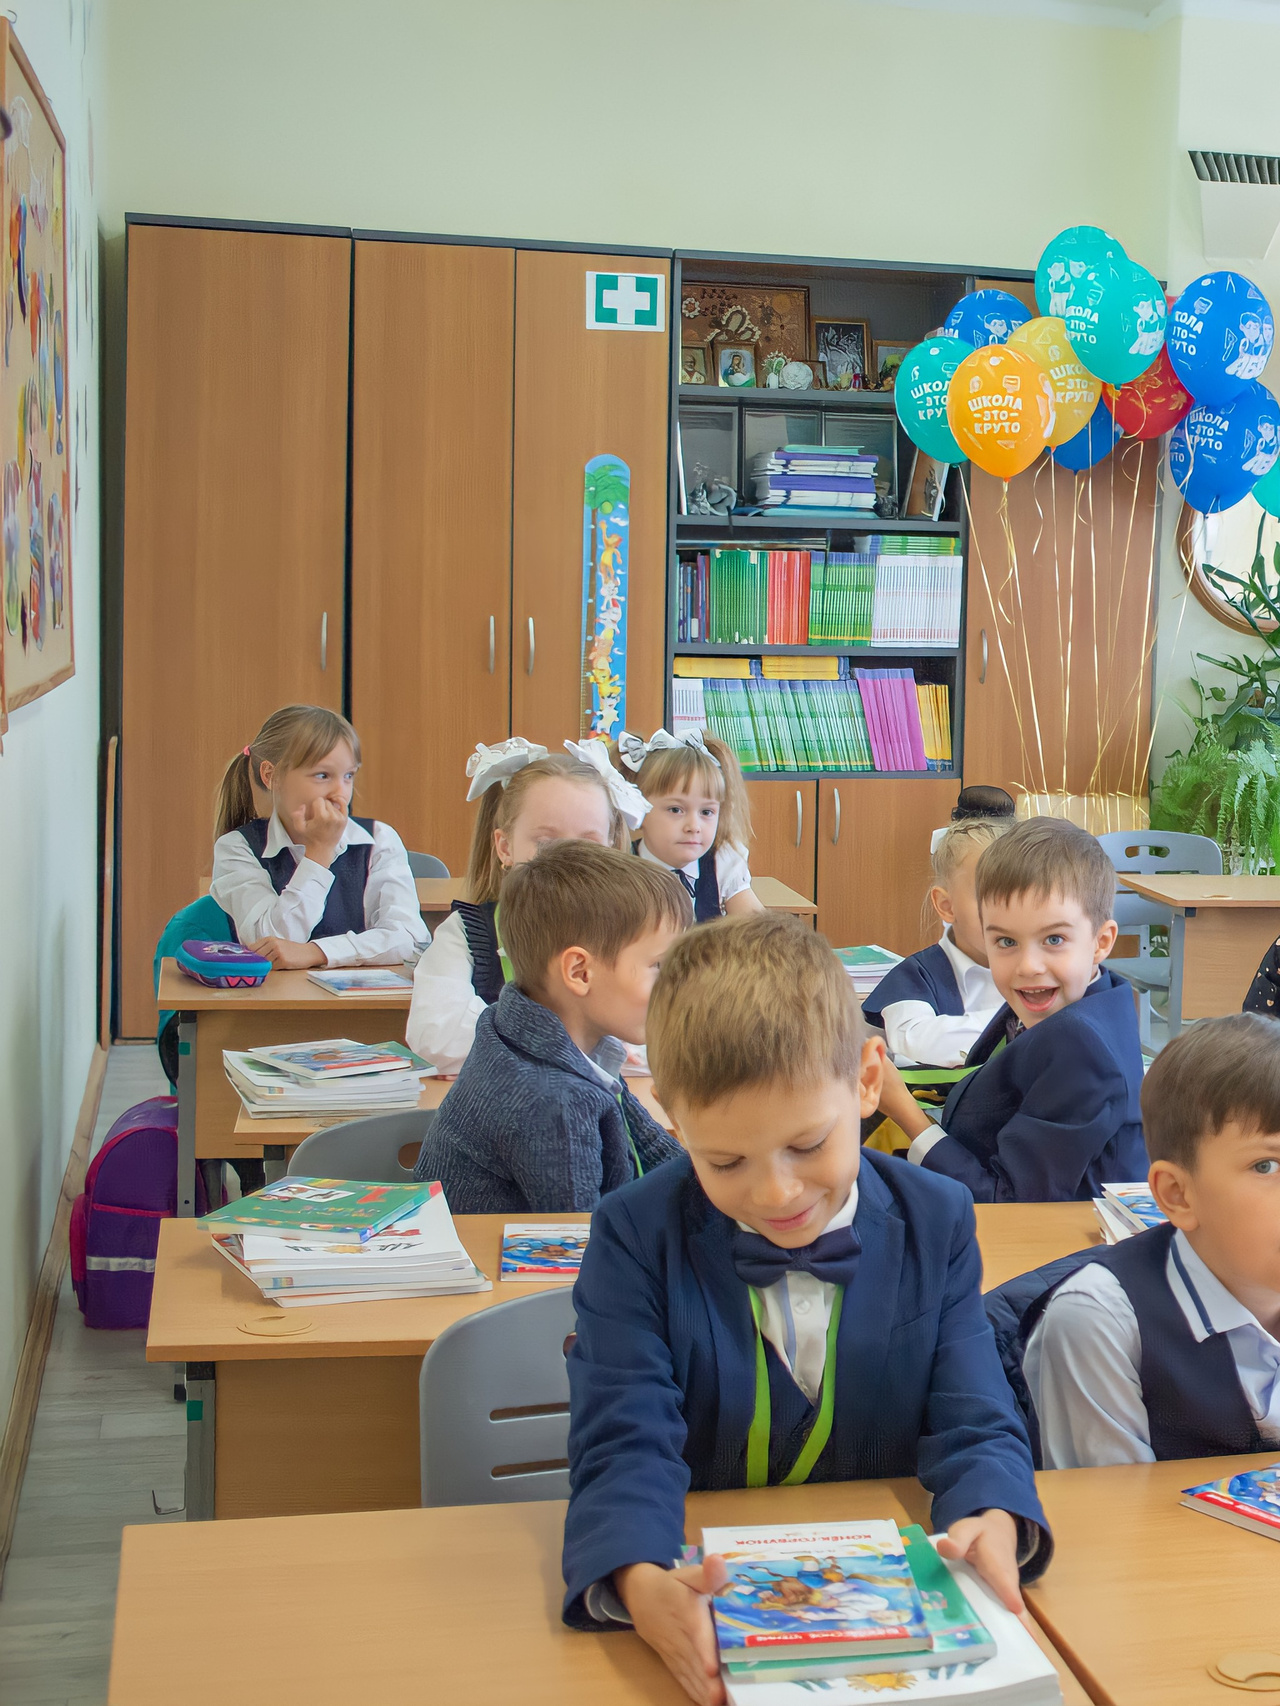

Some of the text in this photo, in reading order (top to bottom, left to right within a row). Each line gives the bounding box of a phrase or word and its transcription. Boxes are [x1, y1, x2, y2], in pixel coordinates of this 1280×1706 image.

[1175, 311, 1204, 334] КОЛА
[1050, 364, 1083, 380] ШКО
[910, 380, 950, 399] ШКОЛ
[1055, 390, 1095, 404] КРУТО
[968, 394, 1023, 411] ШКОЛА
[974, 422, 1021, 434] КРУТО
[1190, 411, 1229, 431] ШКОЛА
